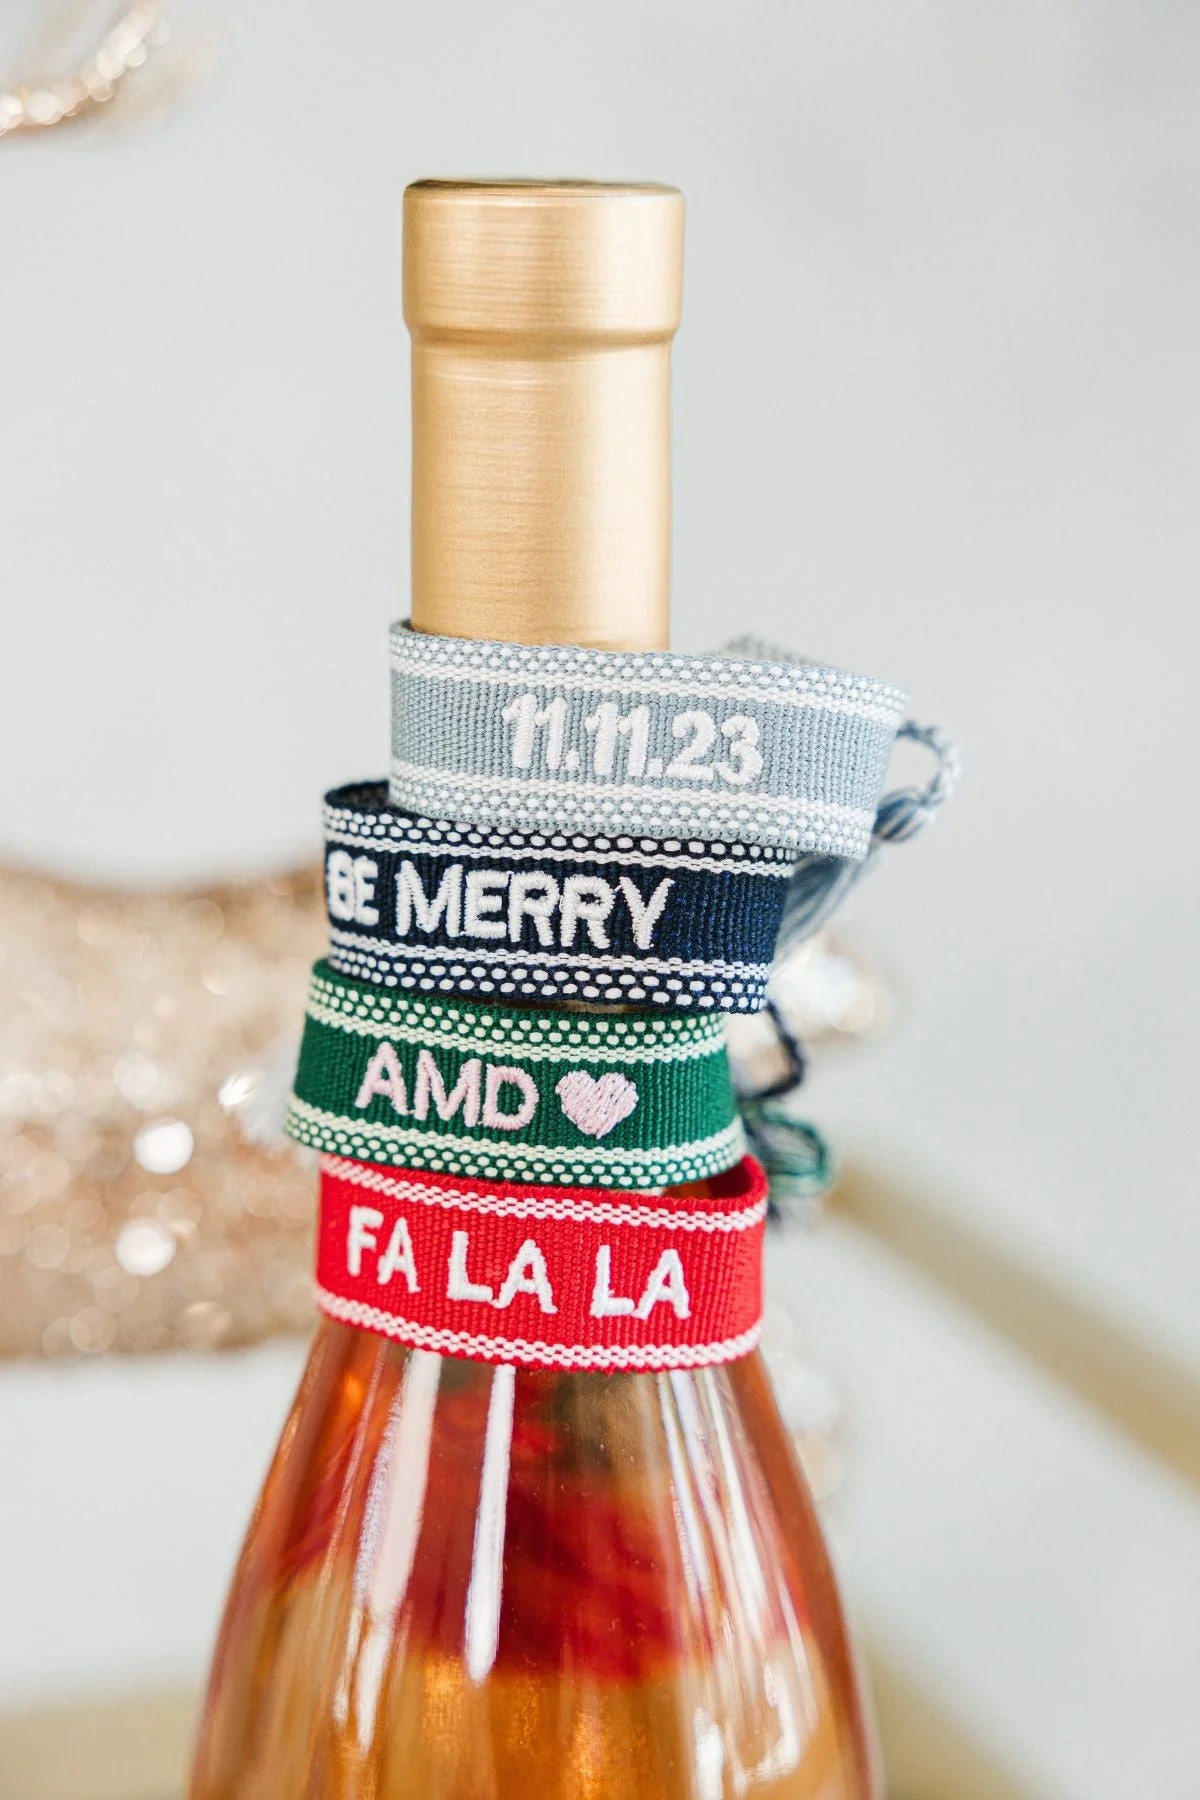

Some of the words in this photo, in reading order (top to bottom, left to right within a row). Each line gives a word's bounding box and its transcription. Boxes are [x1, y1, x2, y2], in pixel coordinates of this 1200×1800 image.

[501, 693, 764, 785] 11.11.23
[326, 850, 379, 926] BE
[395, 859, 675, 949] MERRY
[354, 1041, 539, 1131] AMD
[347, 1205, 421, 1293] FA
[446, 1230, 558, 1313] LA
[590, 1244, 691, 1320] LA
